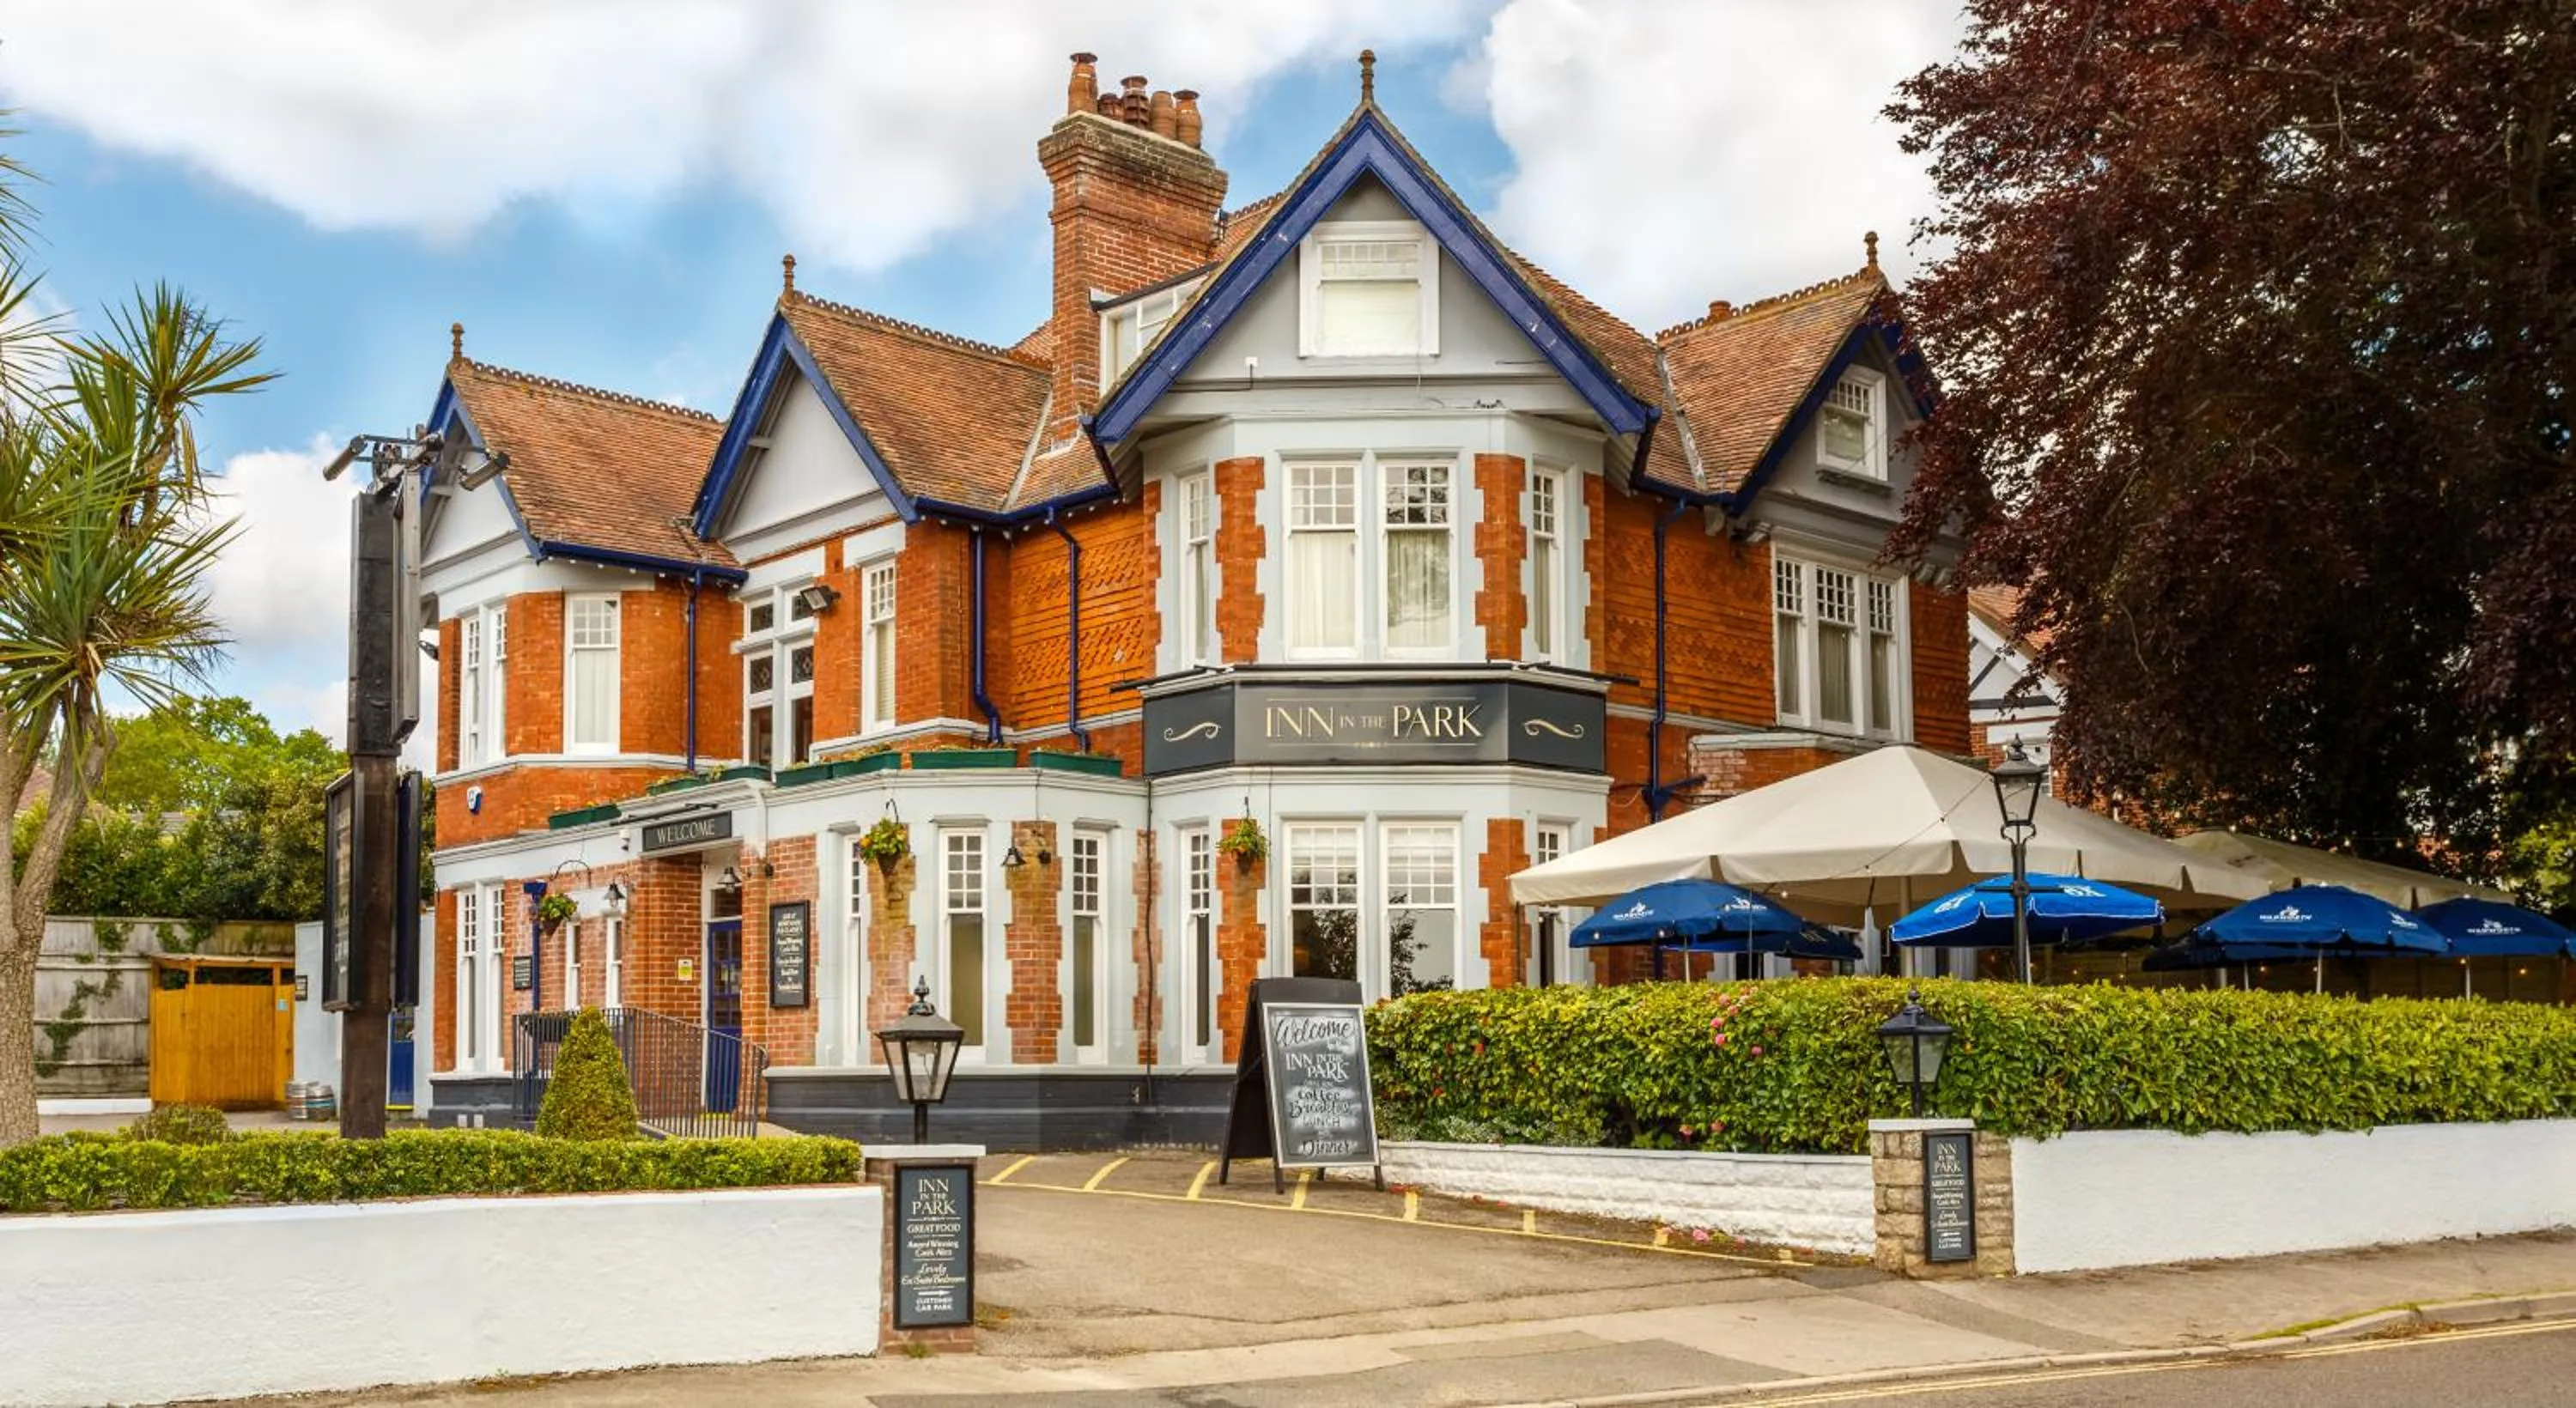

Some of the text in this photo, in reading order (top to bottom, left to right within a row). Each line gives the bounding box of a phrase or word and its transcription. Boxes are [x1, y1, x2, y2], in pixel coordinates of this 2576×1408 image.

[1266, 705, 1484, 739] INN IN THE PARK
[657, 818, 715, 847] WELCOME
[1274, 1017, 1354, 1047] Welcome
[1285, 1053, 1313, 1071] INN
[1307, 1062, 1350, 1083] PARK
[1937, 1143, 1957, 1155] INN
[1934, 1160, 1962, 1174] PARK
[919, 1178, 949, 1193] INN
[912, 1199, 957, 1215] PARK
[907, 1223, 961, 1234] GREAT FOOD
